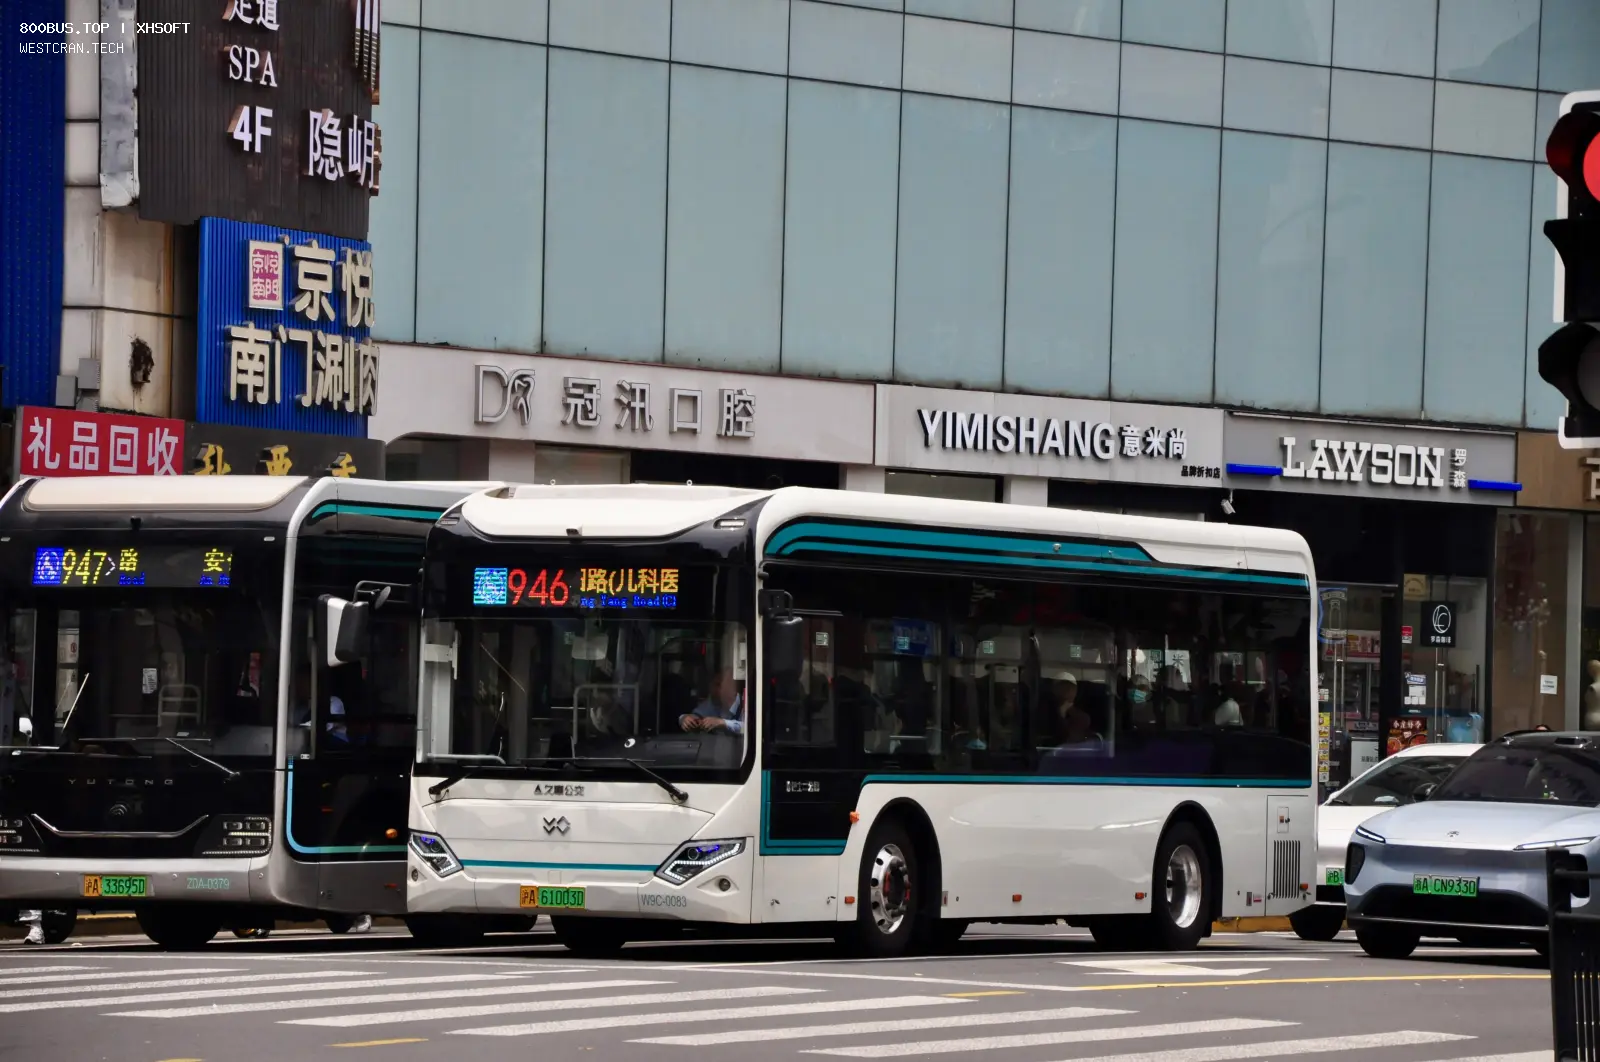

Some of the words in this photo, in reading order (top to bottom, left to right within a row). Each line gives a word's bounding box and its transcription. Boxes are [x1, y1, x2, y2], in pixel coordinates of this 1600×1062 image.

[229, 45, 278, 87] SPA
[233, 106, 273, 153] 4F
[295, 240, 375, 328] 京悦
[230, 322, 379, 416] 南门涮肉
[27, 416, 180, 475] 礼品回收
[918, 409, 1115, 460] YIMISHANG
[1119, 425, 1187, 460] 意米尚
[1180, 465, 1220, 478] 品牌折扣店
[1281, 436, 1444, 488] LAWSON
[1453, 448, 1467, 488] 罗森
[62, 548, 107, 585] 947
[508, 569, 569, 605] 946
[68, 778, 173, 786] YUTONG
[186, 877, 230, 890] ZDA-0379
[641, 894, 687, 907] W9C-0083
